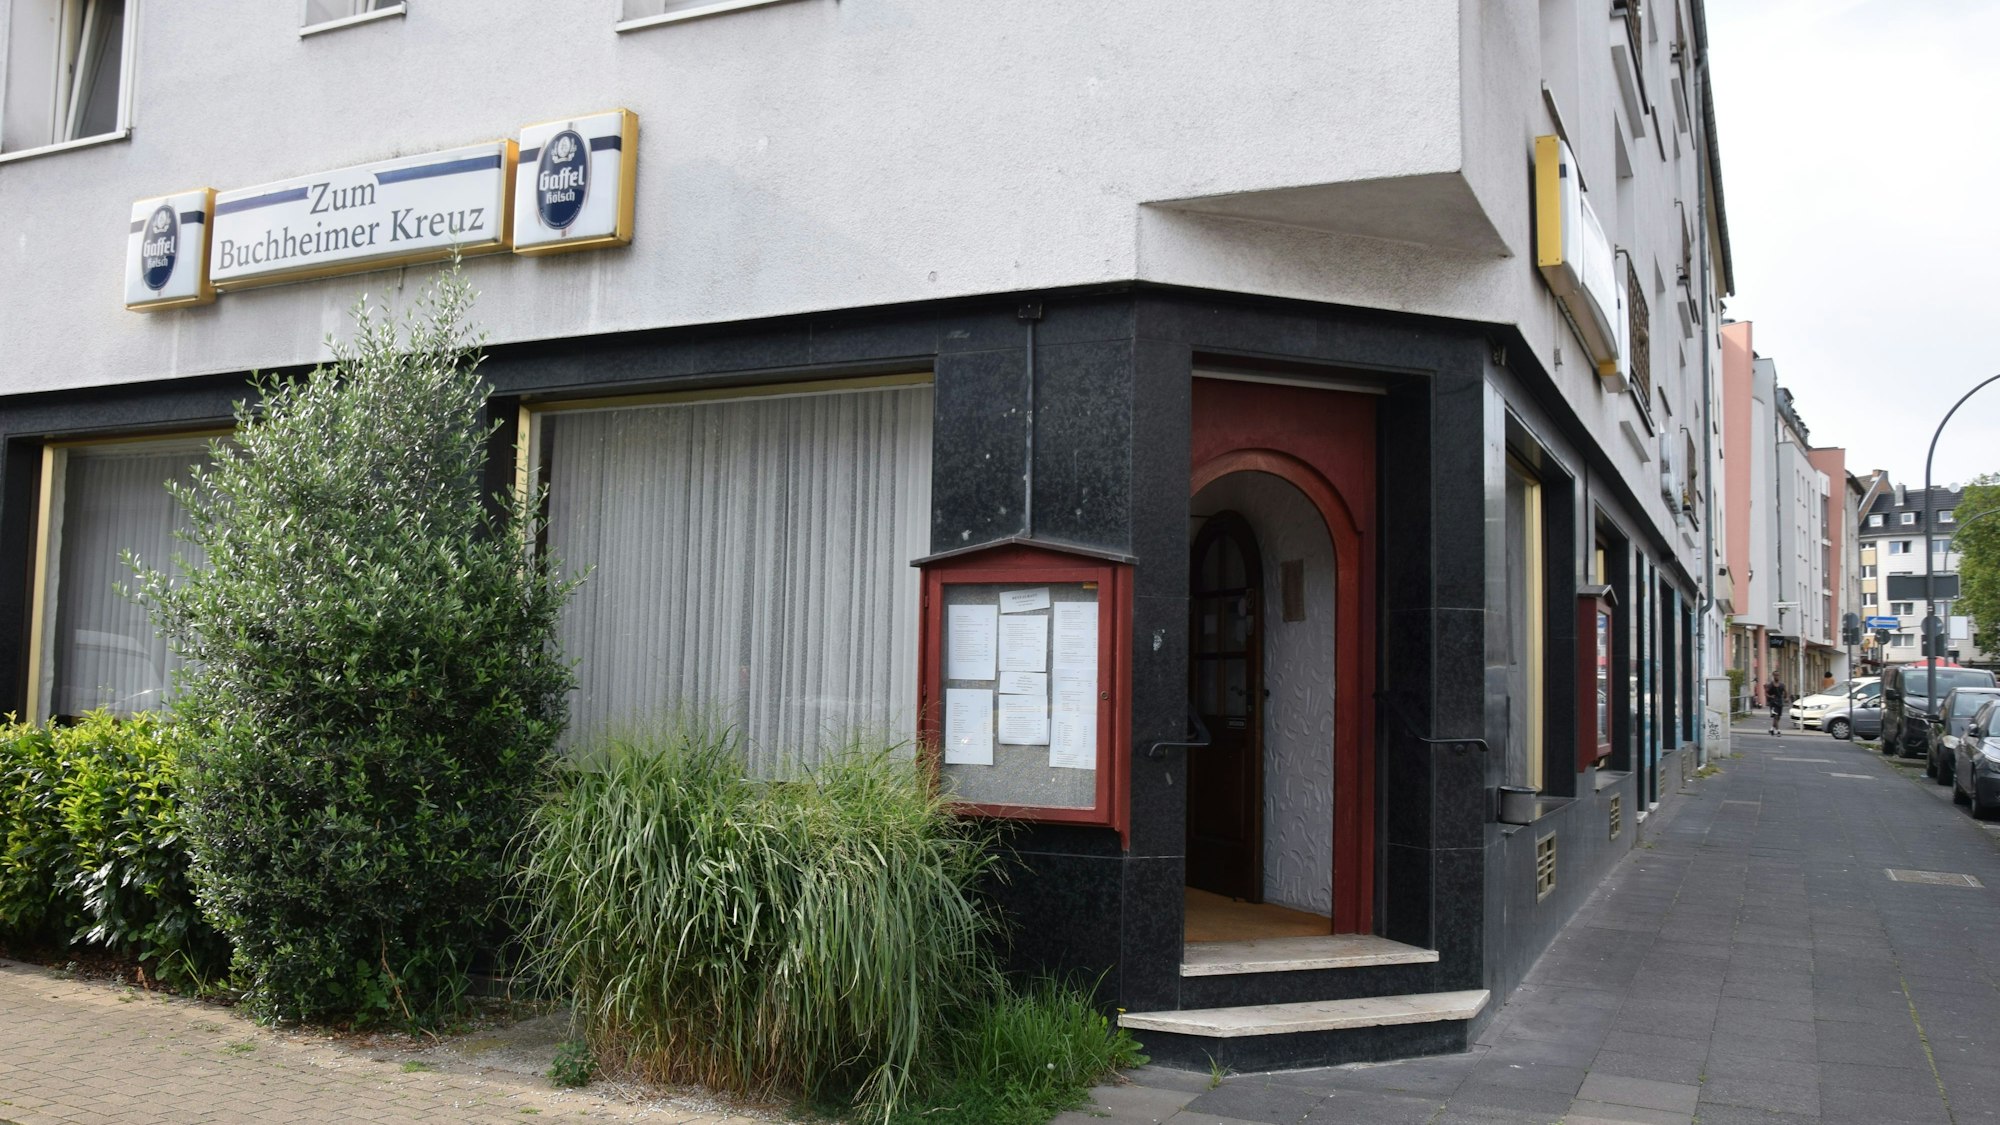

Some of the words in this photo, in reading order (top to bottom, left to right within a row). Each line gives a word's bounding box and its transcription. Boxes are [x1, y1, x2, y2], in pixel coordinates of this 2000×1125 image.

[539, 165, 585, 191] Gaffel
[310, 182, 376, 214] Zum
[546, 188, 576, 204] Kölsch
[143, 235, 176, 257] Gaffel
[218, 221, 380, 270] Buchheimer
[389, 207, 485, 242] Kreuz
